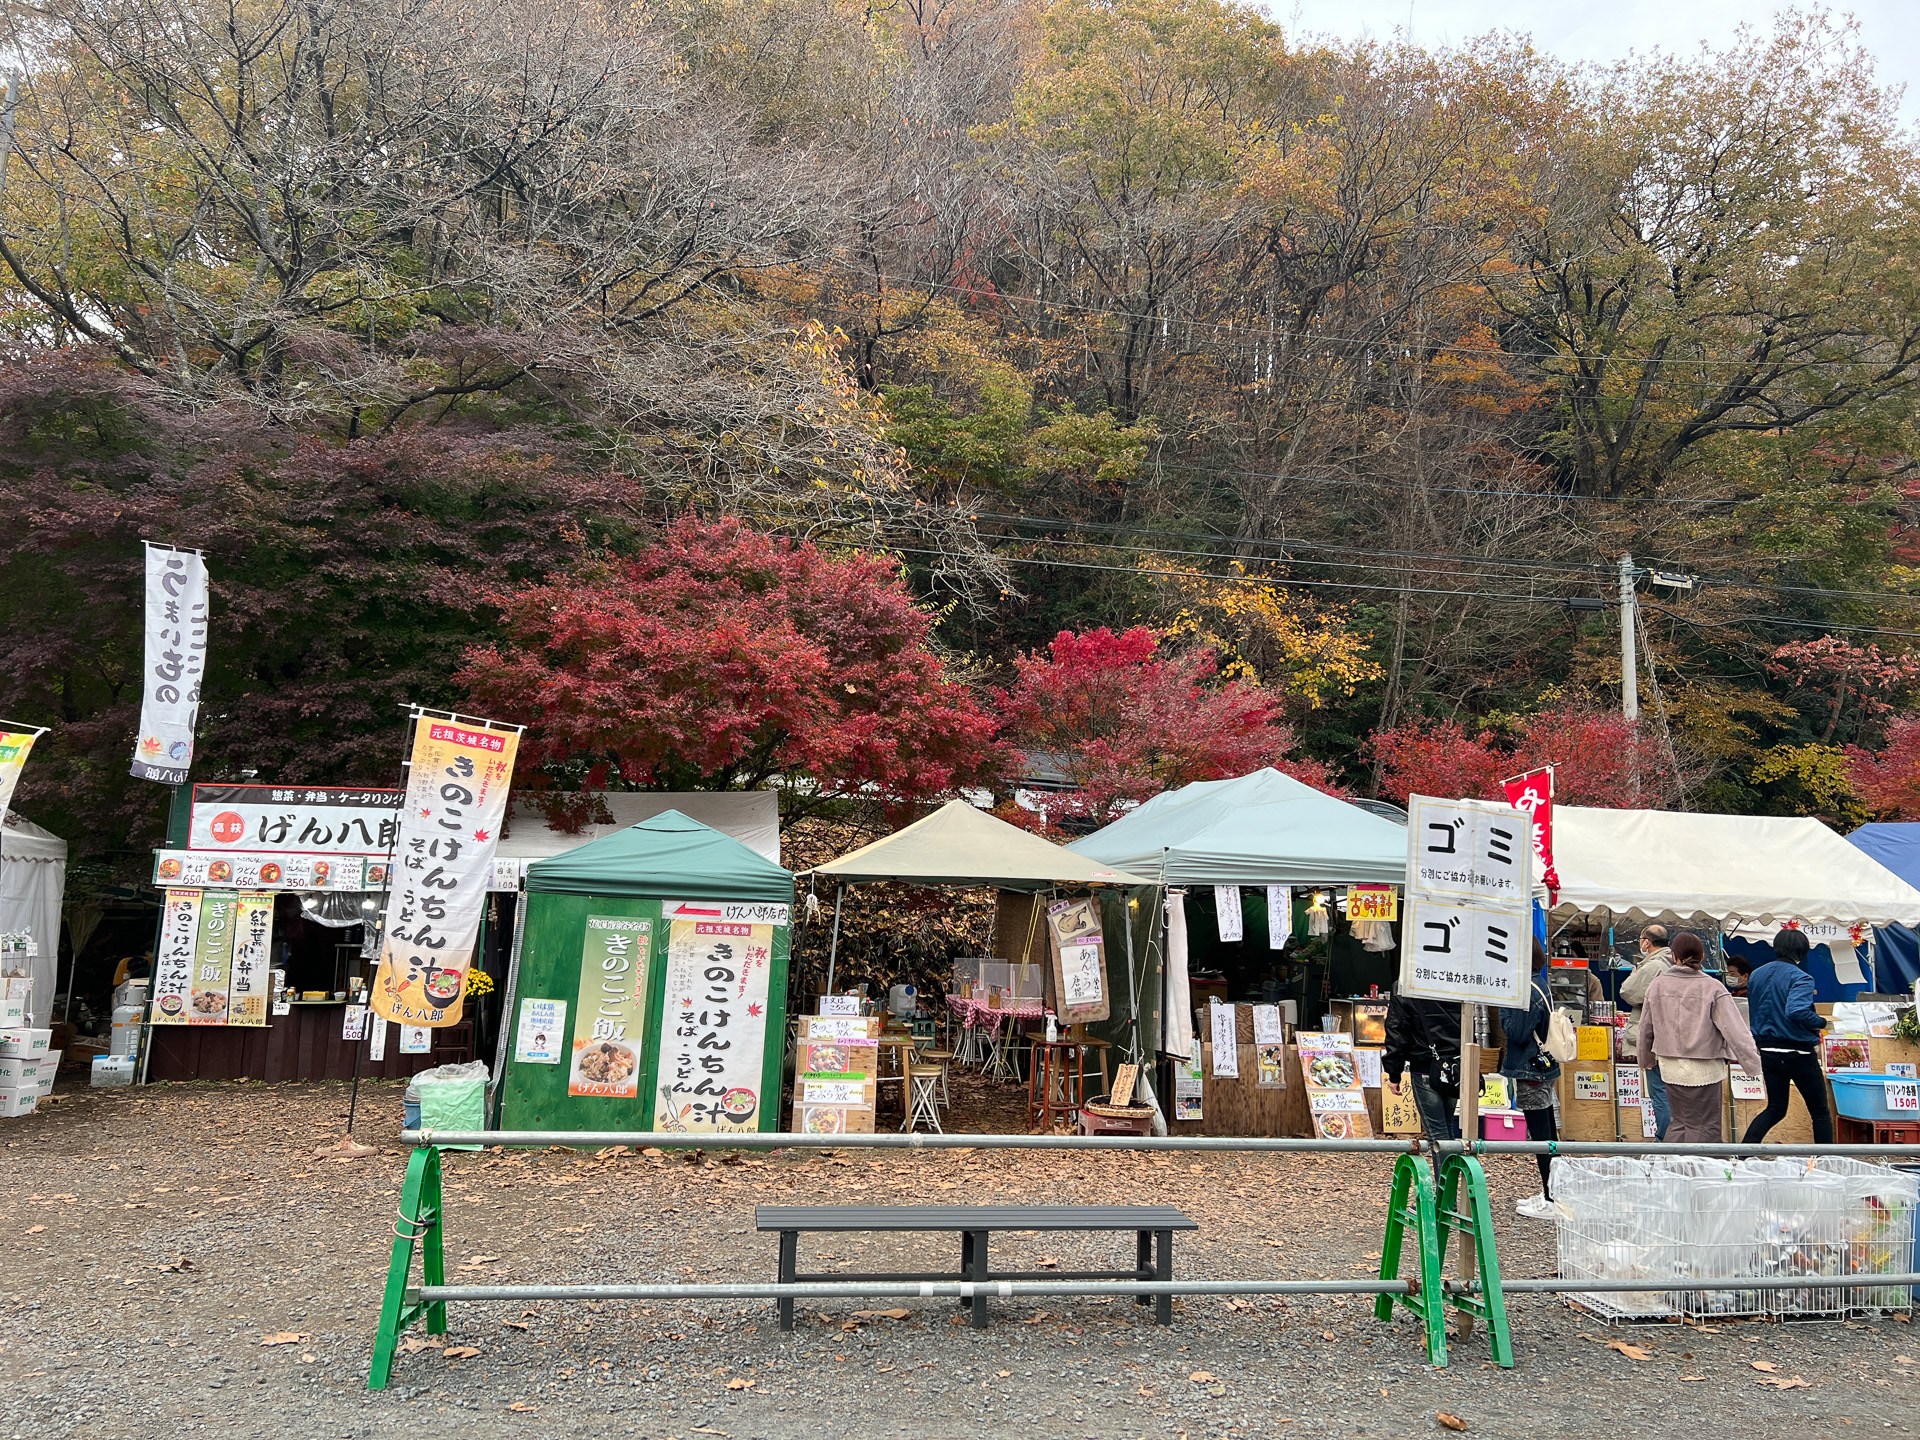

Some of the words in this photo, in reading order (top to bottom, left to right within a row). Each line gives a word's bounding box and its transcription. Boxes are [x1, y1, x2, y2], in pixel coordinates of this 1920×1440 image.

[431, 727, 502, 751] 元祖茨城名物
[495, 760, 508, 781] 秋を
[271, 789, 404, 805] 惣菜・弁当・ケータリング
[213, 821, 243, 834] 高萩
[1428, 816, 1513, 865] ゴミ
[187, 864, 208, 873] そば
[237, 867, 259, 875] うどん
[407, 756, 474, 985] きのこけんちん汁
[183, 875, 206, 885] 650円
[235, 877, 258, 887] 650円
[391, 838, 427, 941] そば・うどん
[1350, 892, 1393, 917] 古時計
[726, 905, 788, 921] げん八郎店内
[250, 909, 268, 946] 紅葉
[696, 924, 751, 935] 元祖茨城名物
[1801, 923, 1838, 936] でれすけ
[201, 901, 228, 982] きのこご飯
[1272, 932, 1287, 941] 350
[1423, 915, 1508, 963] ゴミ
[169, 901, 193, 994] きのこけんちん汁
[755, 946, 768, 968] 秋を
[236, 944, 254, 992] 小弁当
[1079, 948, 1092, 990] あんこう
[1415, 967, 1511, 989] 分別にご協力をお願いします。
[592, 934, 632, 1042] きのこご飯
[821, 997, 846, 1005] 注文は
[829, 1004, 857, 1012] こちらです
[392, 1003, 444, 1021] げん八郎
[191, 1017, 225, 1025] げん八郎
[811, 1022, 833, 1034] きのこ
[693, 943, 735, 1124] きのこけんちん汁
[672, 1011, 699, 1093] そば・うどん
[1849, 1061, 1870, 1069] 600円
[1617, 1070, 1639, 1078] 缶ビール
[578, 1083, 628, 1095] げん八郎
[806, 1090, 834, 1101] 天ぷら
[1618, 1088, 1640, 1096] 缶酎ハイ
[1886, 1085, 1917, 1096] ドリンク各種
[1314, 1098, 1336, 1110] 天ぷら
[1402, 1080, 1414, 1122] あんこう
[1894, 1097, 1918, 1109] 150円
